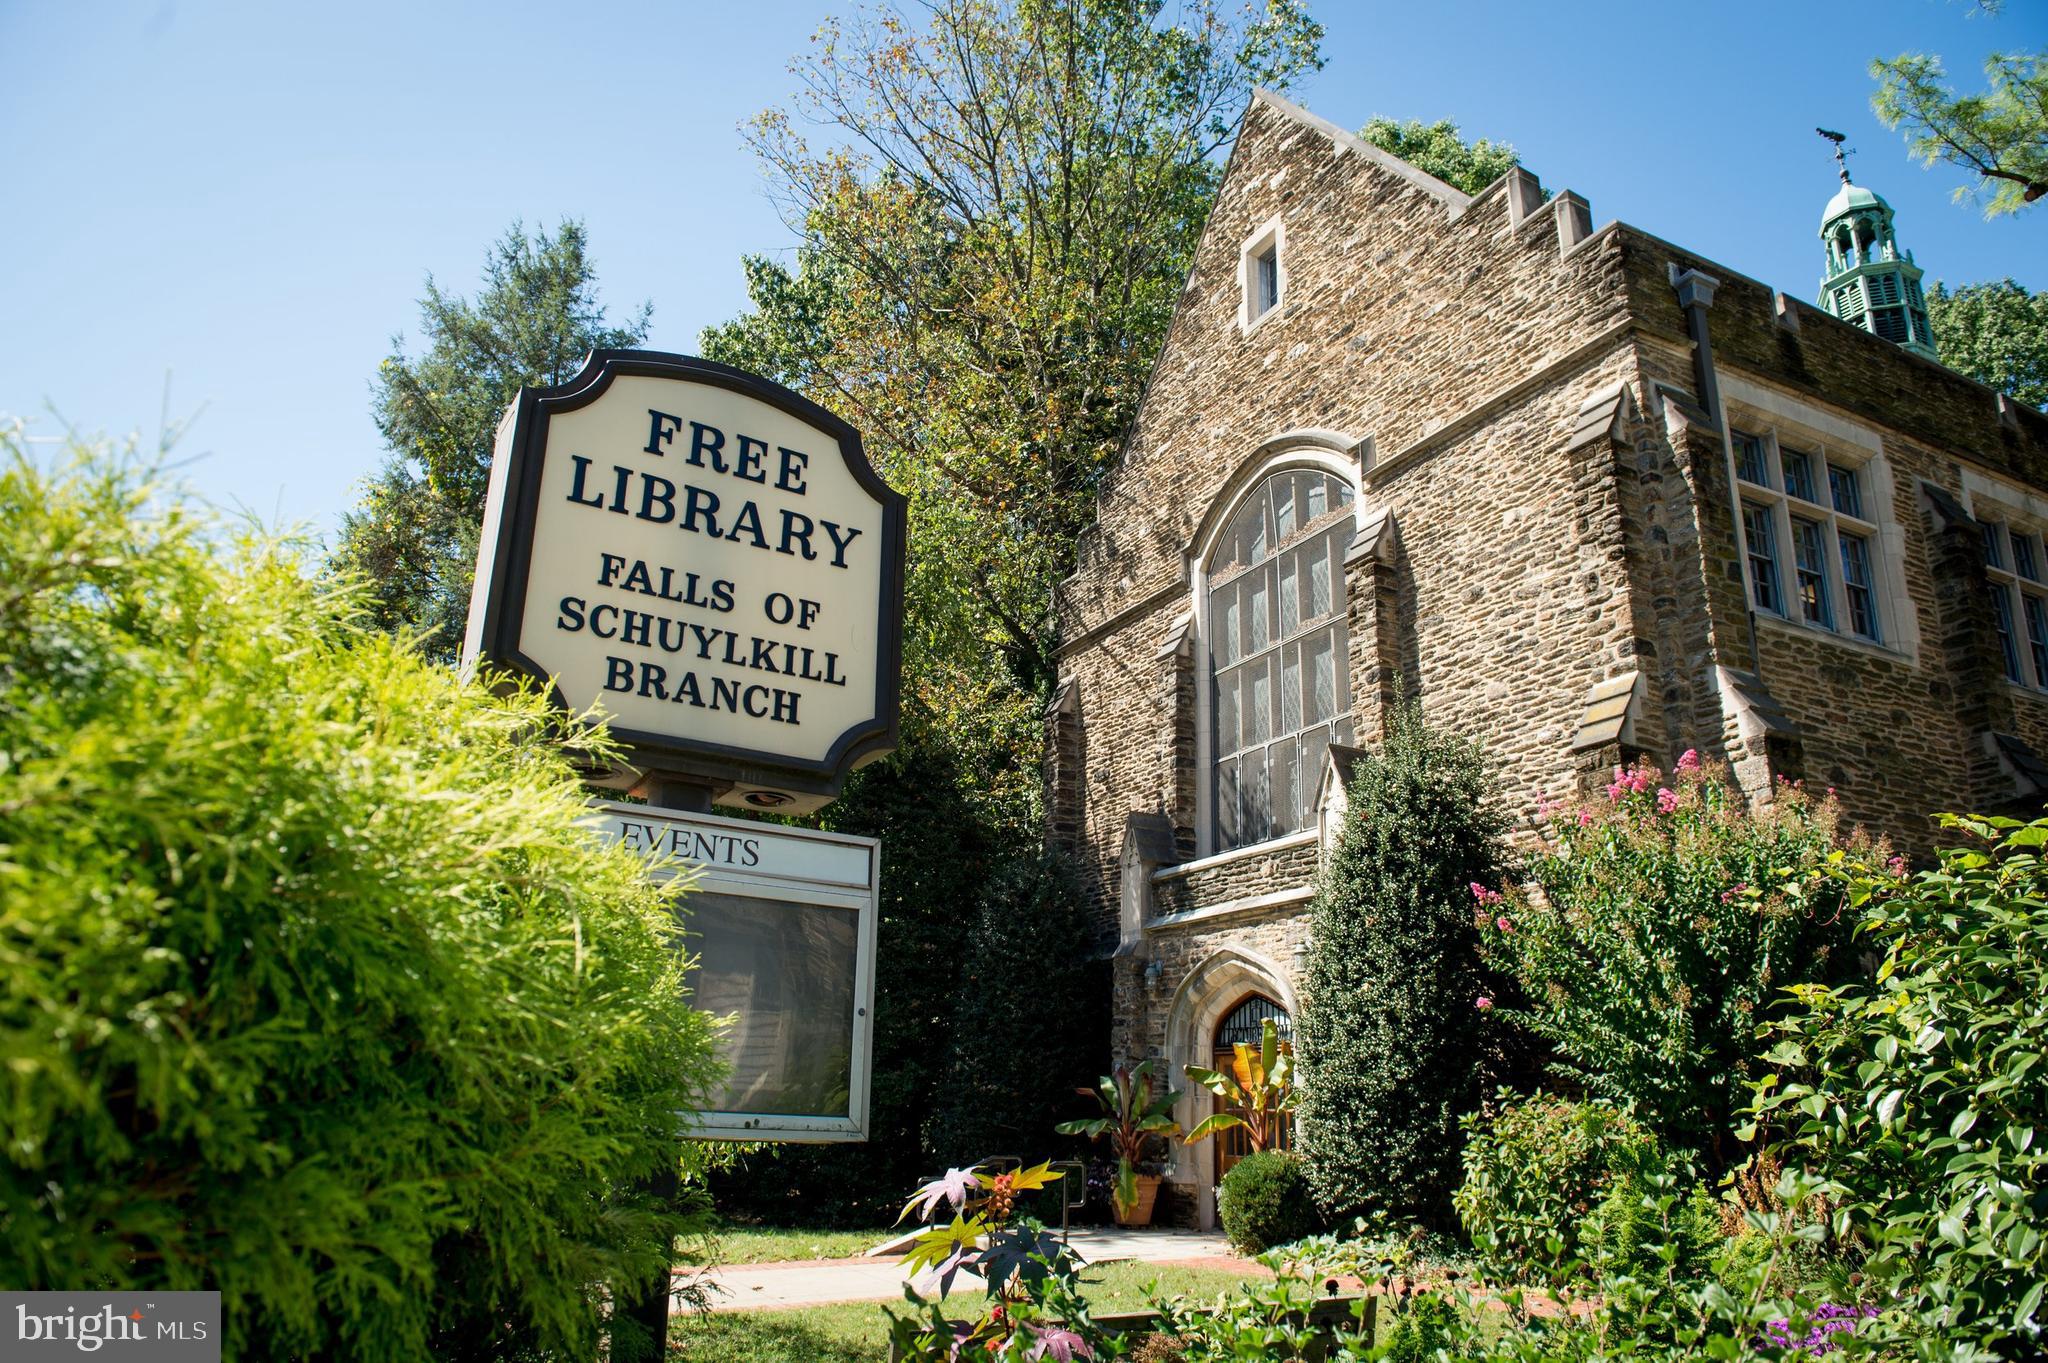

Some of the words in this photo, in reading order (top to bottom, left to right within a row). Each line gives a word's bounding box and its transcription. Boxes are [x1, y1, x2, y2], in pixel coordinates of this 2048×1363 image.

[643, 409, 809, 496] FREE
[566, 455, 863, 569] LIBRARY
[597, 553, 736, 613] FALLS
[764, 592, 821, 631] OF
[557, 597, 847, 687] SCHUYLKILL
[603, 656, 801, 725] BRANCH
[620, 821, 761, 867] EVENTS
